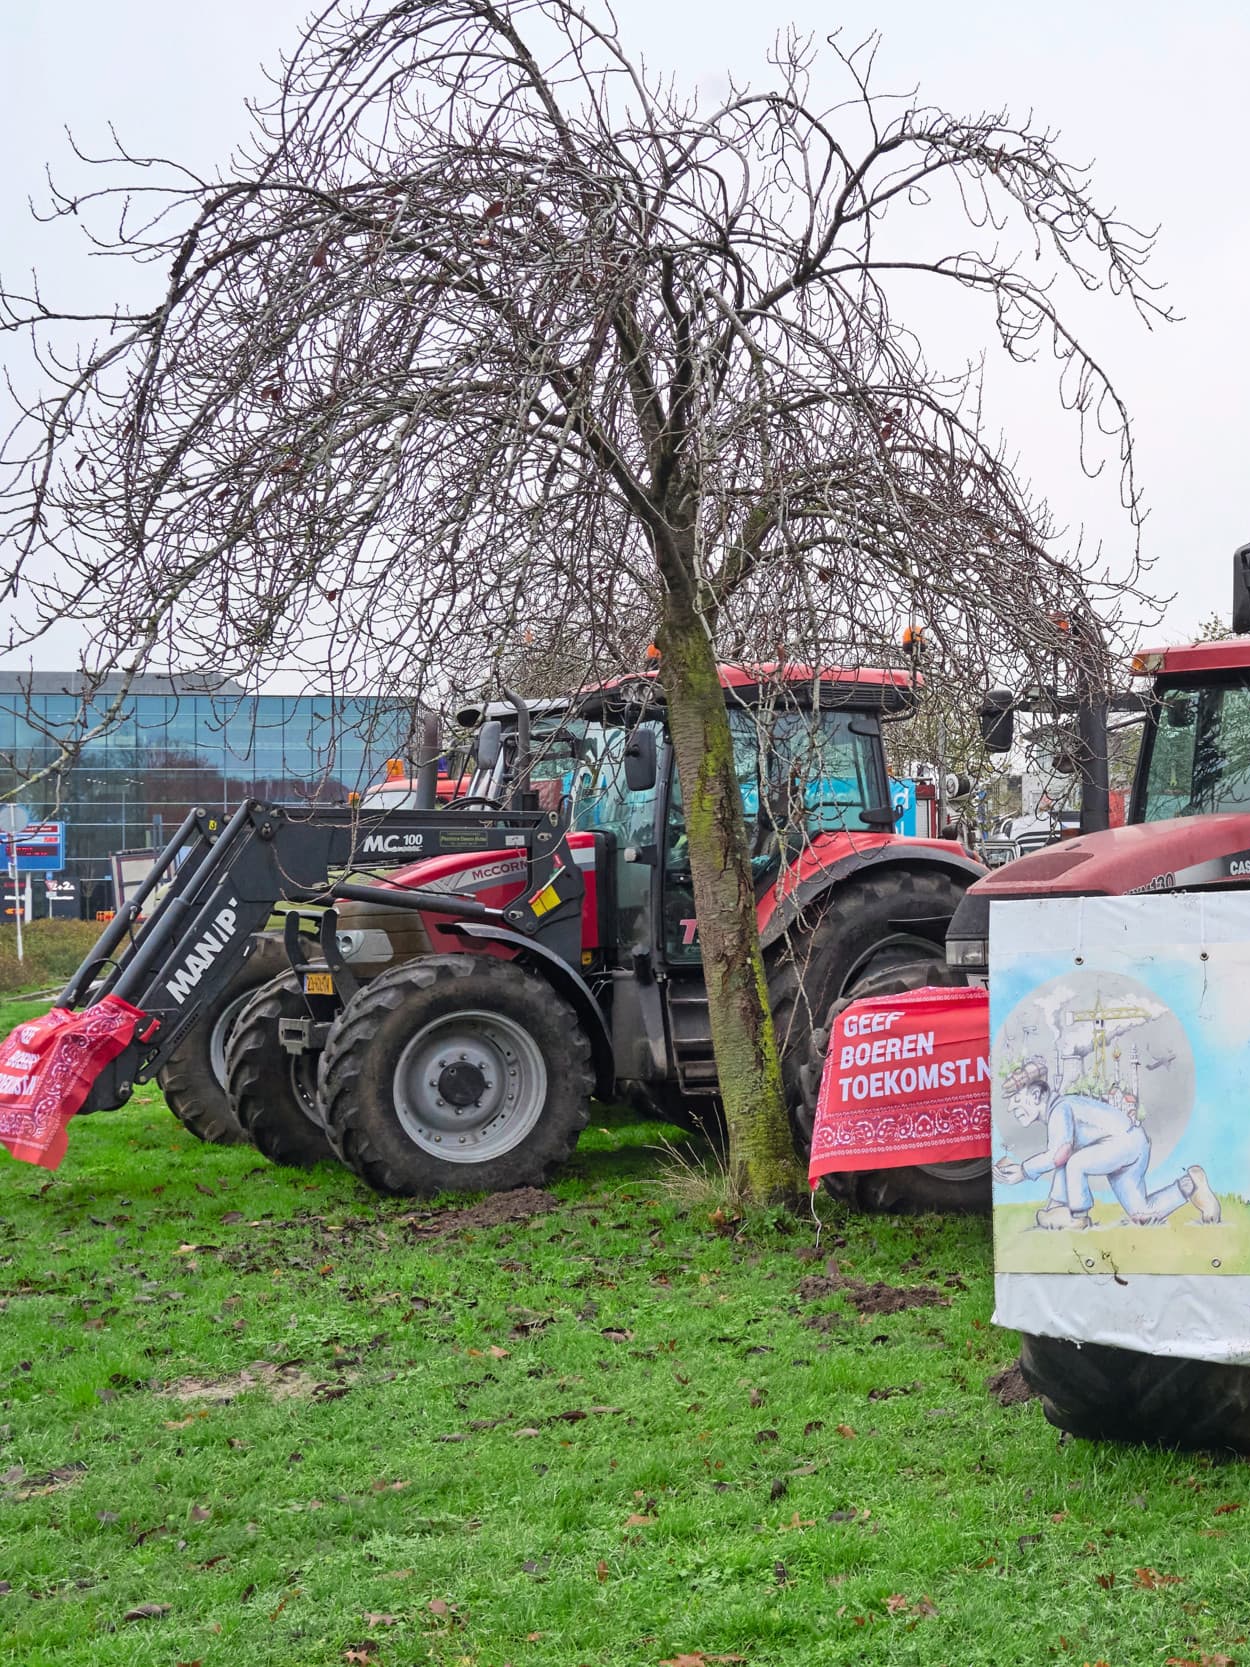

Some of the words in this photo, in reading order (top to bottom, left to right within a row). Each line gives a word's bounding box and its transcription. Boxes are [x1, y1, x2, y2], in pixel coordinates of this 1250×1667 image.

[363, 834, 400, 853] MC
[402, 833, 423, 846] 100
[843, 1011, 905, 1038] GEEF
[840, 1031, 935, 1070] BOEREN
[839, 1055, 991, 1102] TOEKOMST.N
